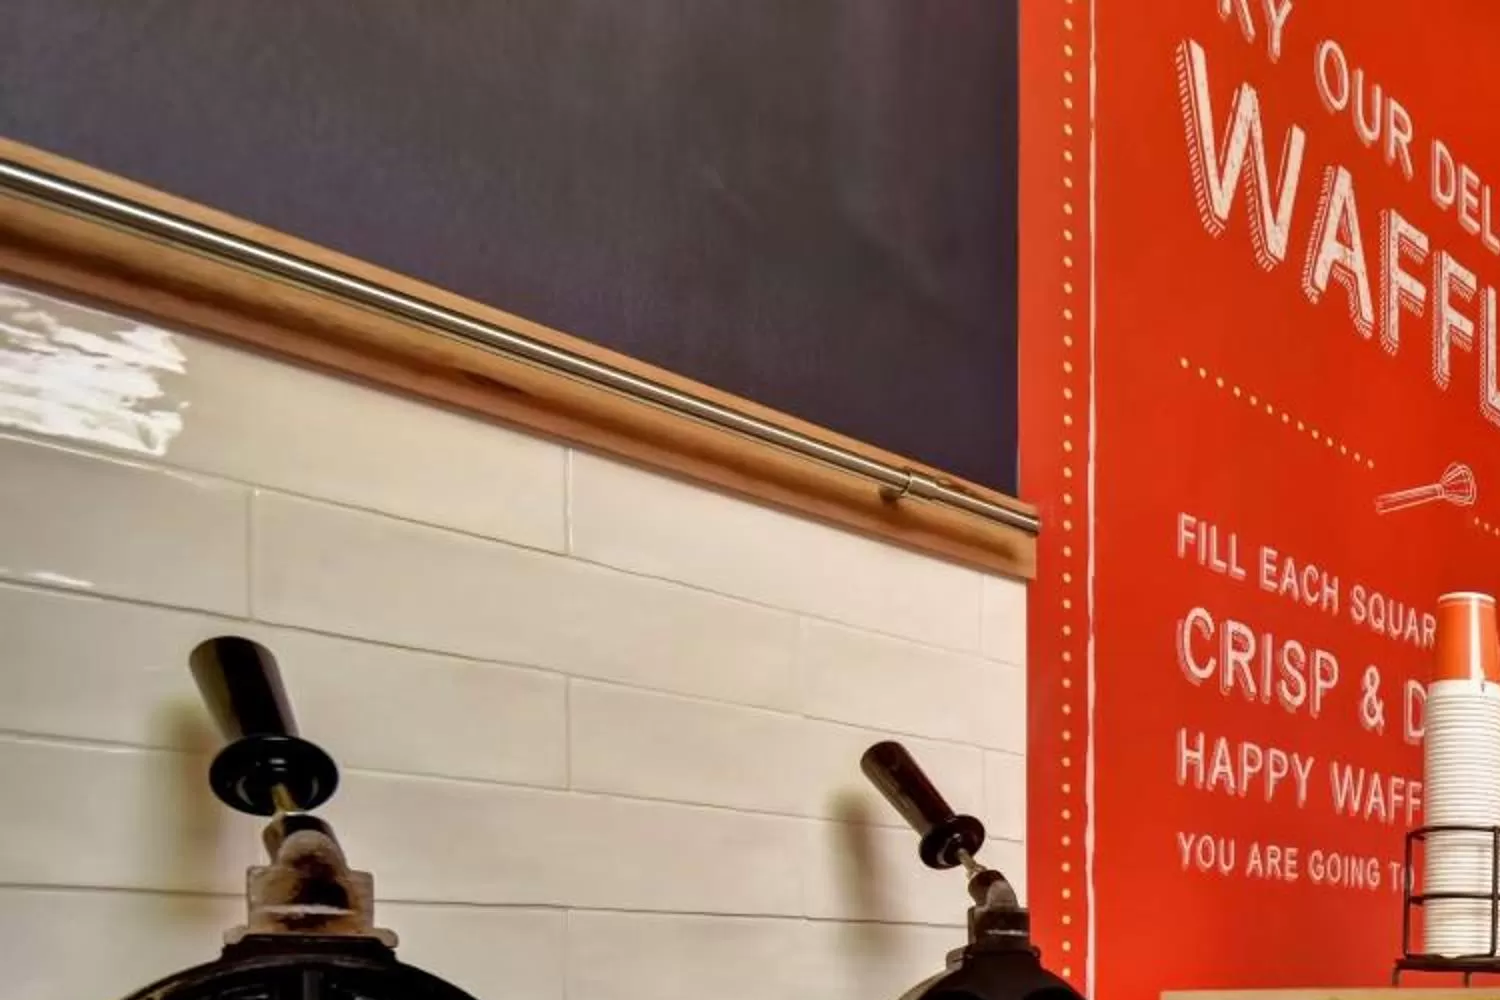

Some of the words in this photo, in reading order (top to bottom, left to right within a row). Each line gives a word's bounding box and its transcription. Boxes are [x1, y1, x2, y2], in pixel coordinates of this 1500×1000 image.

[1314, 39, 1413, 180] OUR
[1177, 512, 1246, 578] FILL
[1259, 545, 1340, 615] EACH
[1350, 584, 1436, 650] SQUAR
[1176, 607, 1339, 718] CRISP
[1360, 664, 1385, 736] &
[1176, 728, 1314, 808] HAPPY
[1329, 760, 1422, 828] WAFF
[1176, 831, 1235, 873] YOU
[1246, 843, 1298, 881] ARE
[1308, 849, 1381, 892] GOING
